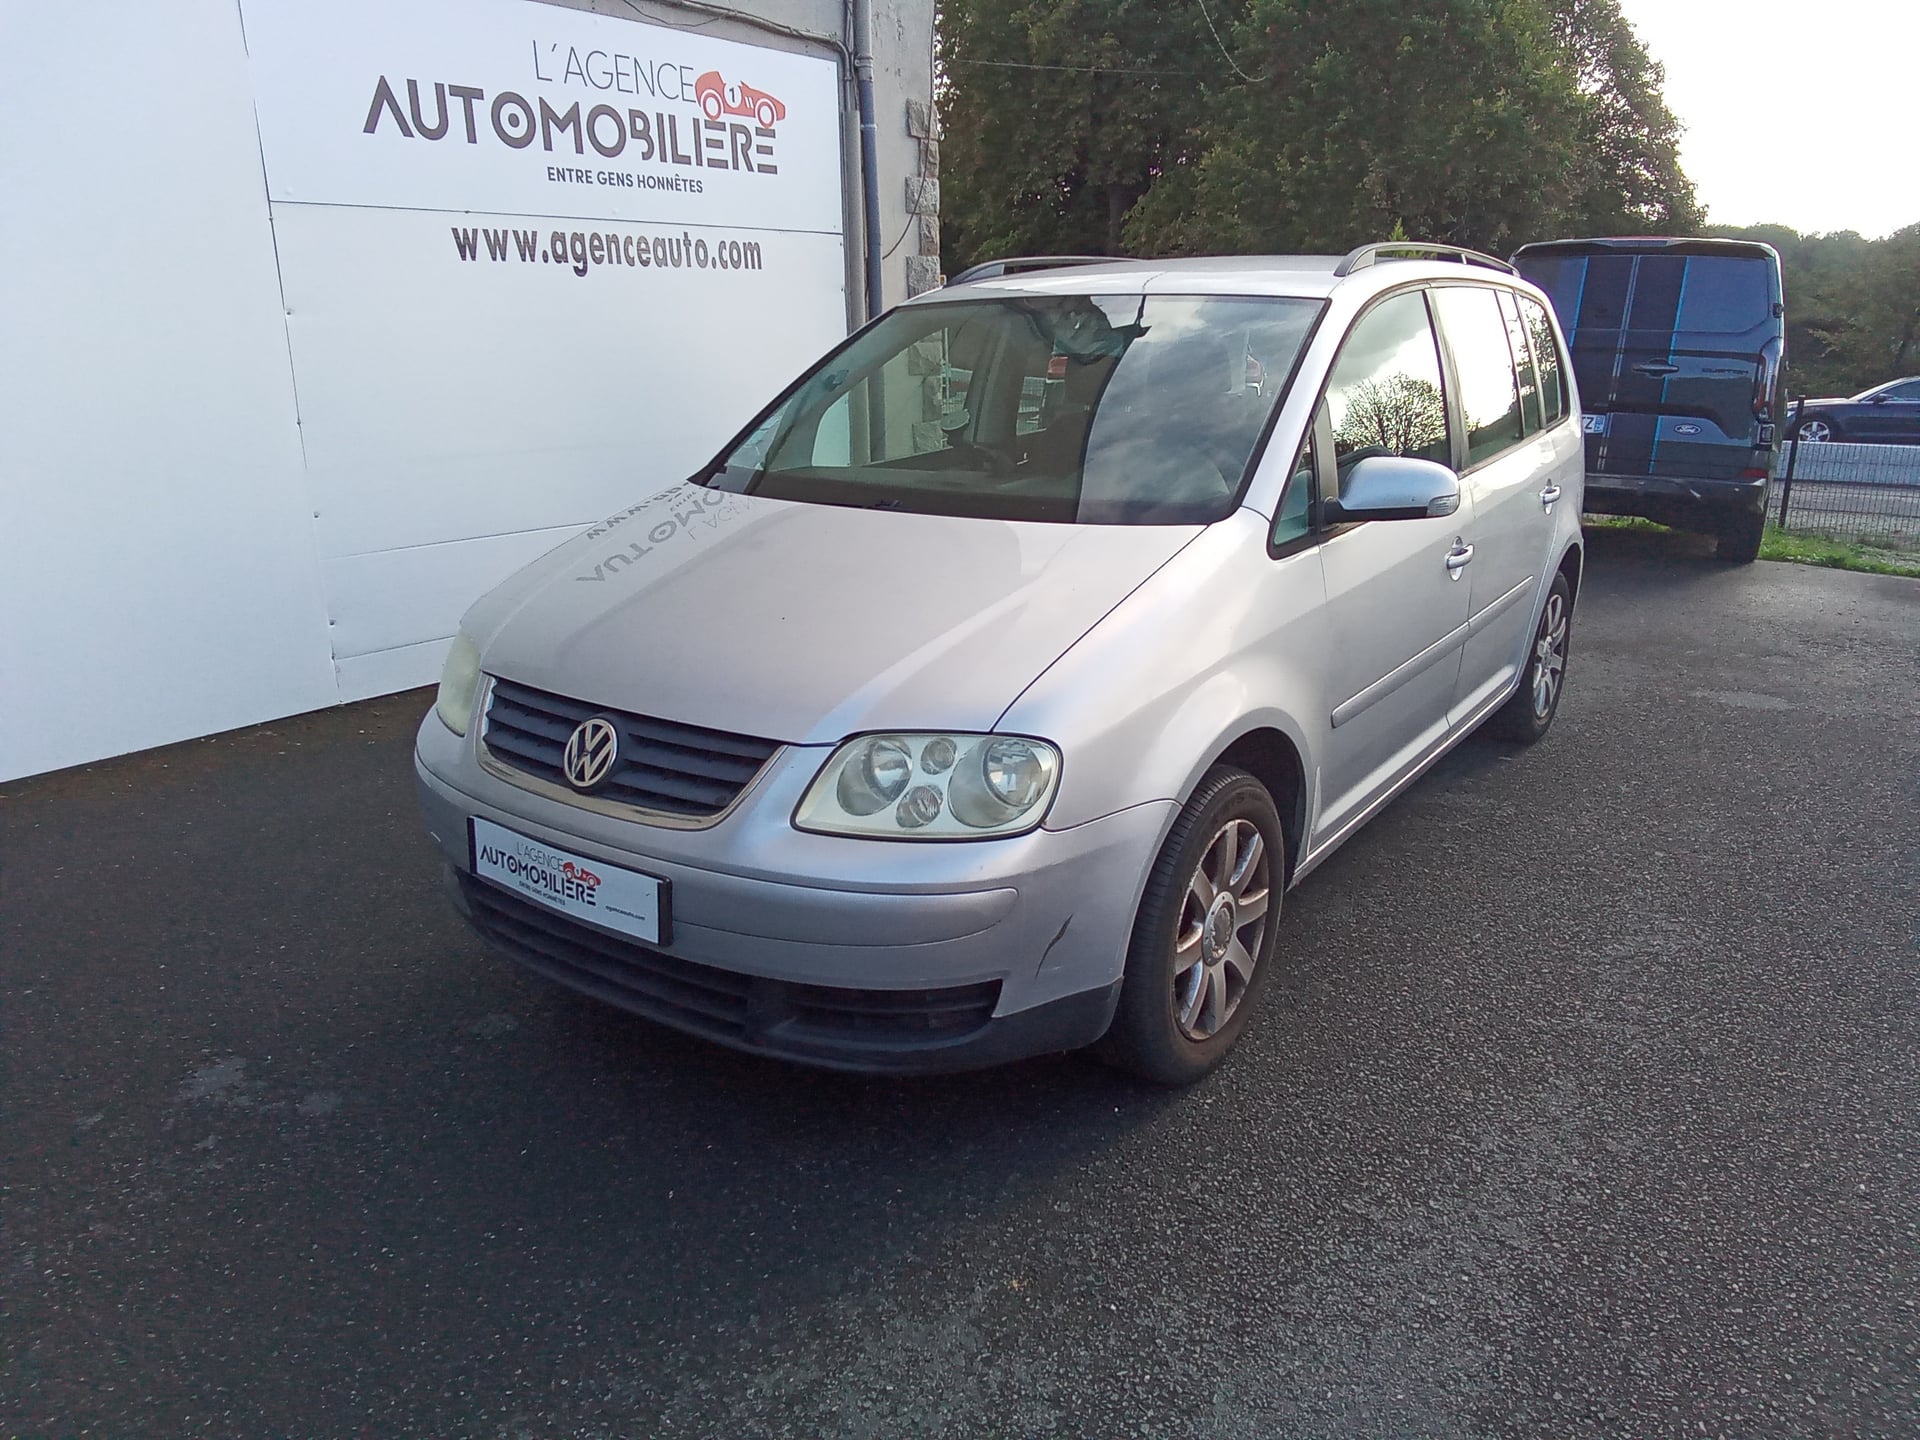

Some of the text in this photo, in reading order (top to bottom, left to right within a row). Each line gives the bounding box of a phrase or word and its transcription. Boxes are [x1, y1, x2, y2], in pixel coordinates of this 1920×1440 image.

[532, 39, 697, 104] L'AGENCE
[728, 87, 736, 103] 1
[547, 166, 704, 194] ENTRE GENS HONNÊTES
[451, 226, 763, 277] www.agenceauto.com
[516, 841, 564, 873] L'AGENCE
